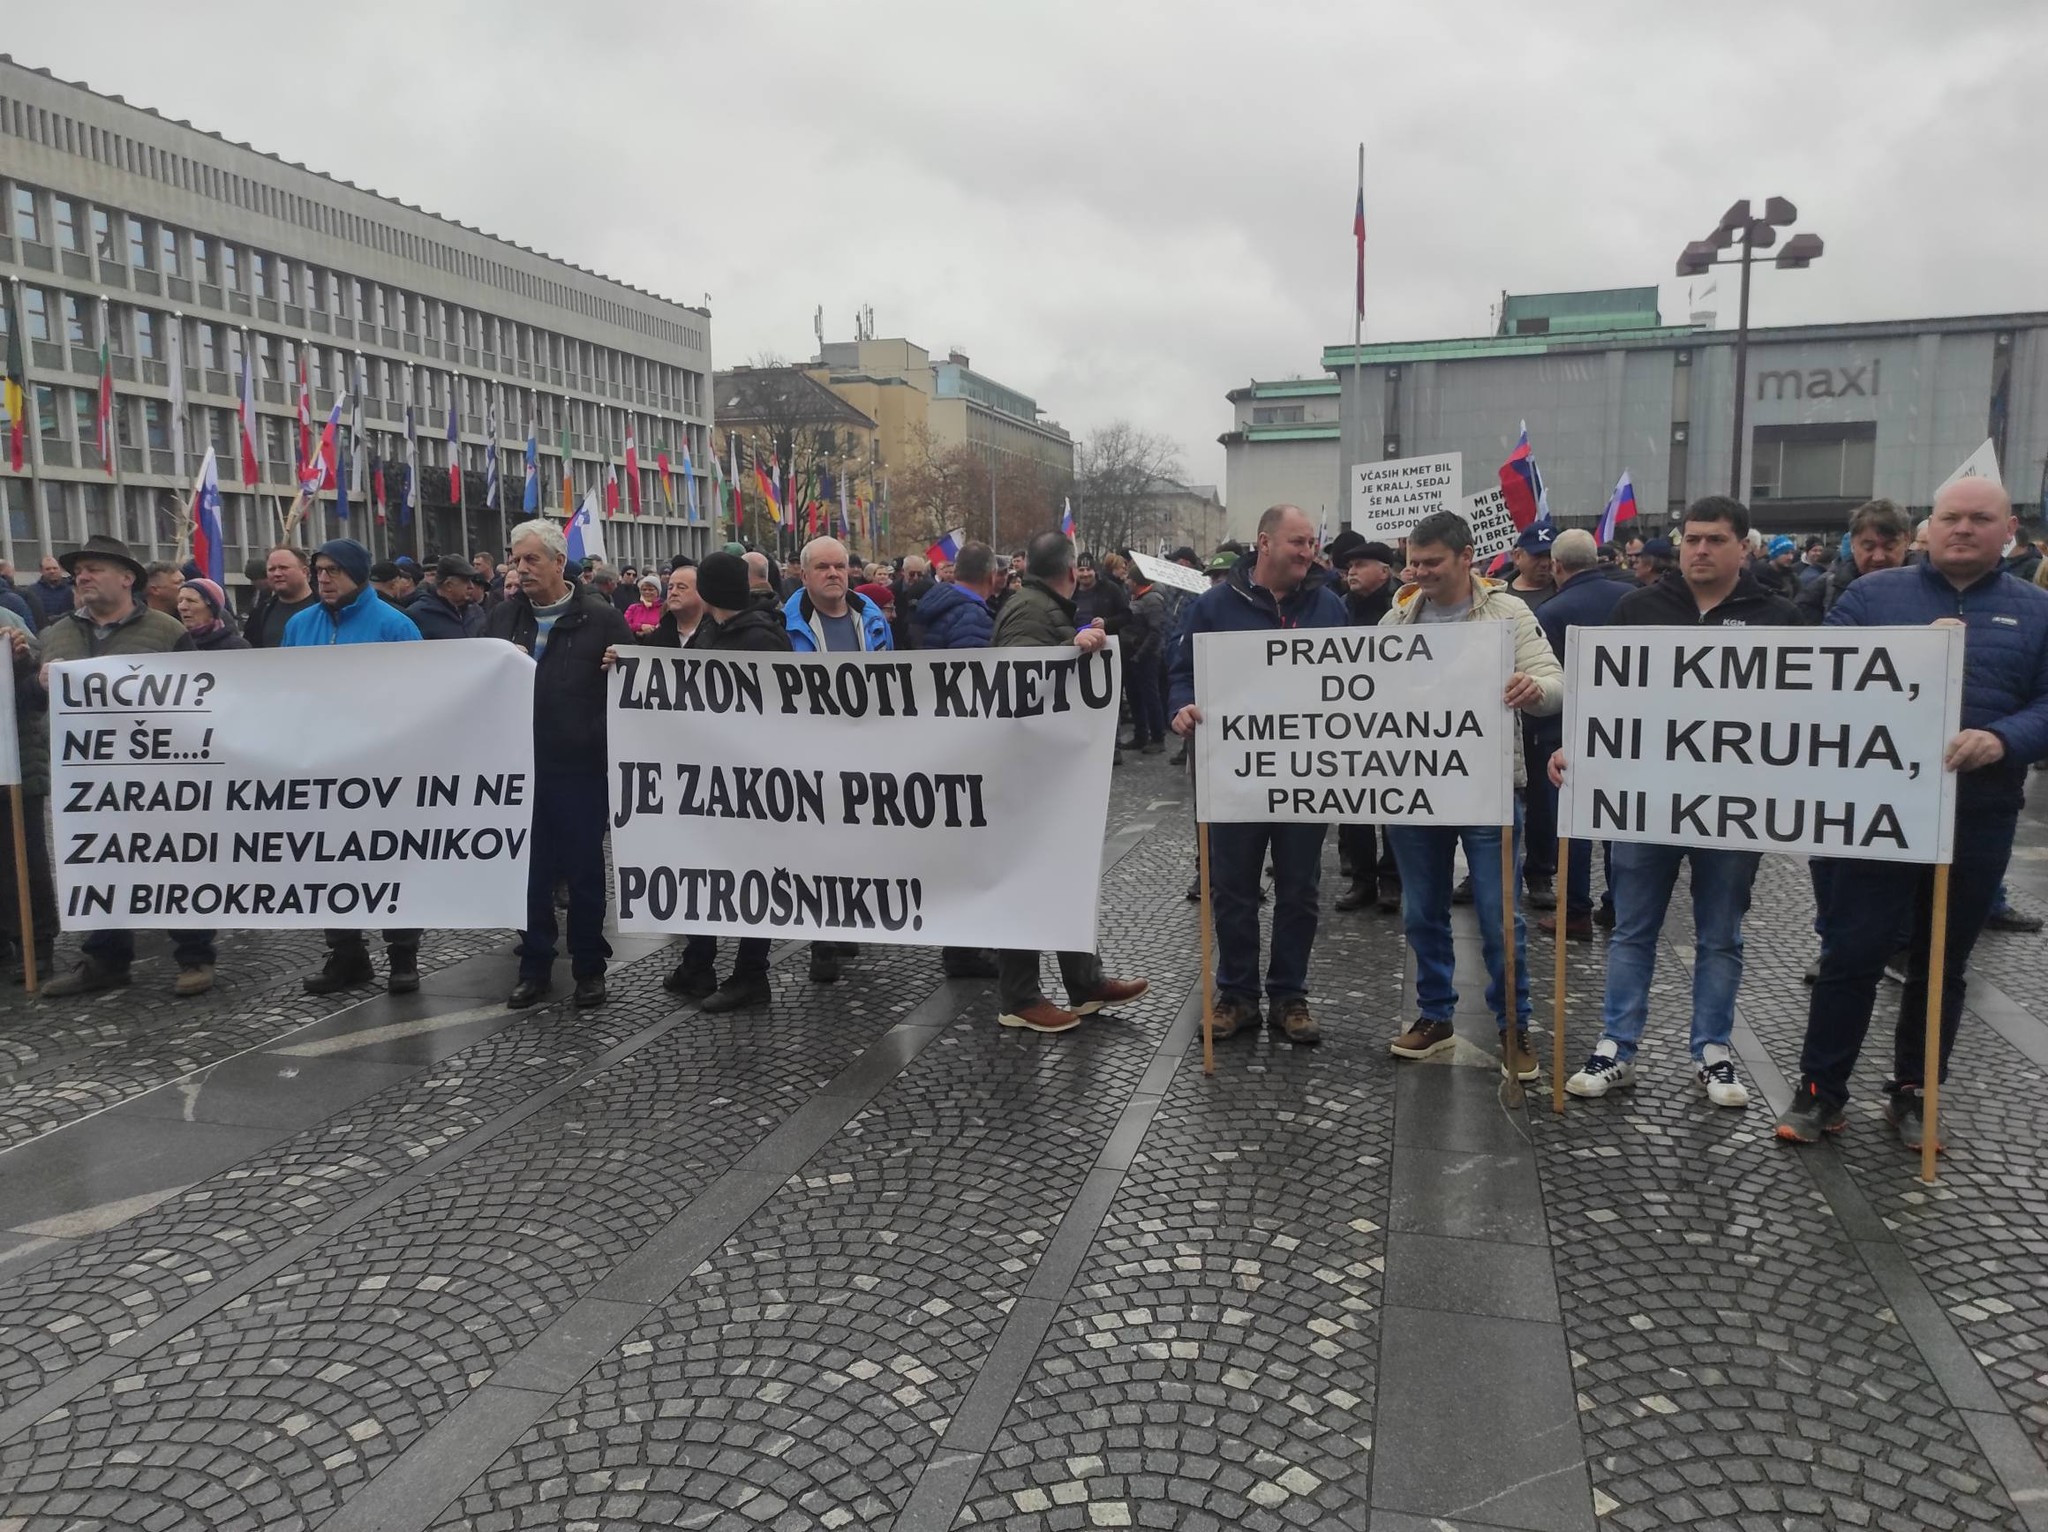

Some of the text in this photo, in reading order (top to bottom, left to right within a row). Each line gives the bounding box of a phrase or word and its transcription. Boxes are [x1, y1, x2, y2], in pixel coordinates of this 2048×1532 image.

[1758, 358, 1881, 401] maxi
[1360, 463, 1452, 481] VČASIH KMET BIL
[1361, 476, 1450, 494] JE KRALJ, SEDAJ
[1368, 501, 1443, 519] ZEMLJI NI VEČ
[1369, 490, 1442, 506] ŠE NA LASTNI
[1473, 495, 1488, 507] MI
[1376, 519, 1420, 531] GOSPOD
[1470, 506, 1493, 521] VAS
[1472, 513, 1513, 533] PREŽIV
[1474, 538, 1515, 557] ZELO T
[1485, 524, 1516, 542] BREZ
[1538, 528, 1551, 542] K
[1266, 633, 1433, 667] PRAVICA
[62, 664, 216, 708] LAČNI?
[614, 649, 1113, 719] ZAKON PROTI KMETU
[1321, 674, 1375, 703] DO
[1594, 645, 1921, 702] NI KMETA,
[62, 719, 214, 761] NE ŠE...!
[1222, 710, 1484, 742] KMETOVANJA
[1234, 749, 1469, 778] JE USTAVNA
[1586, 717, 1921, 780] NI KRUHA,
[64, 773, 526, 813] ZARADI KMETOV IN NE
[612, 761, 988, 829] JE ZAKON PROTI
[1267, 787, 1434, 815] PRAVICA
[1592, 788, 1909, 850] NI KRUHA
[64, 827, 528, 865] ZARADI NEVLADNIKOV
[67, 882, 401, 917] IN BIROKRATOV!
[618, 865, 923, 932] POTROŠNIKU!
